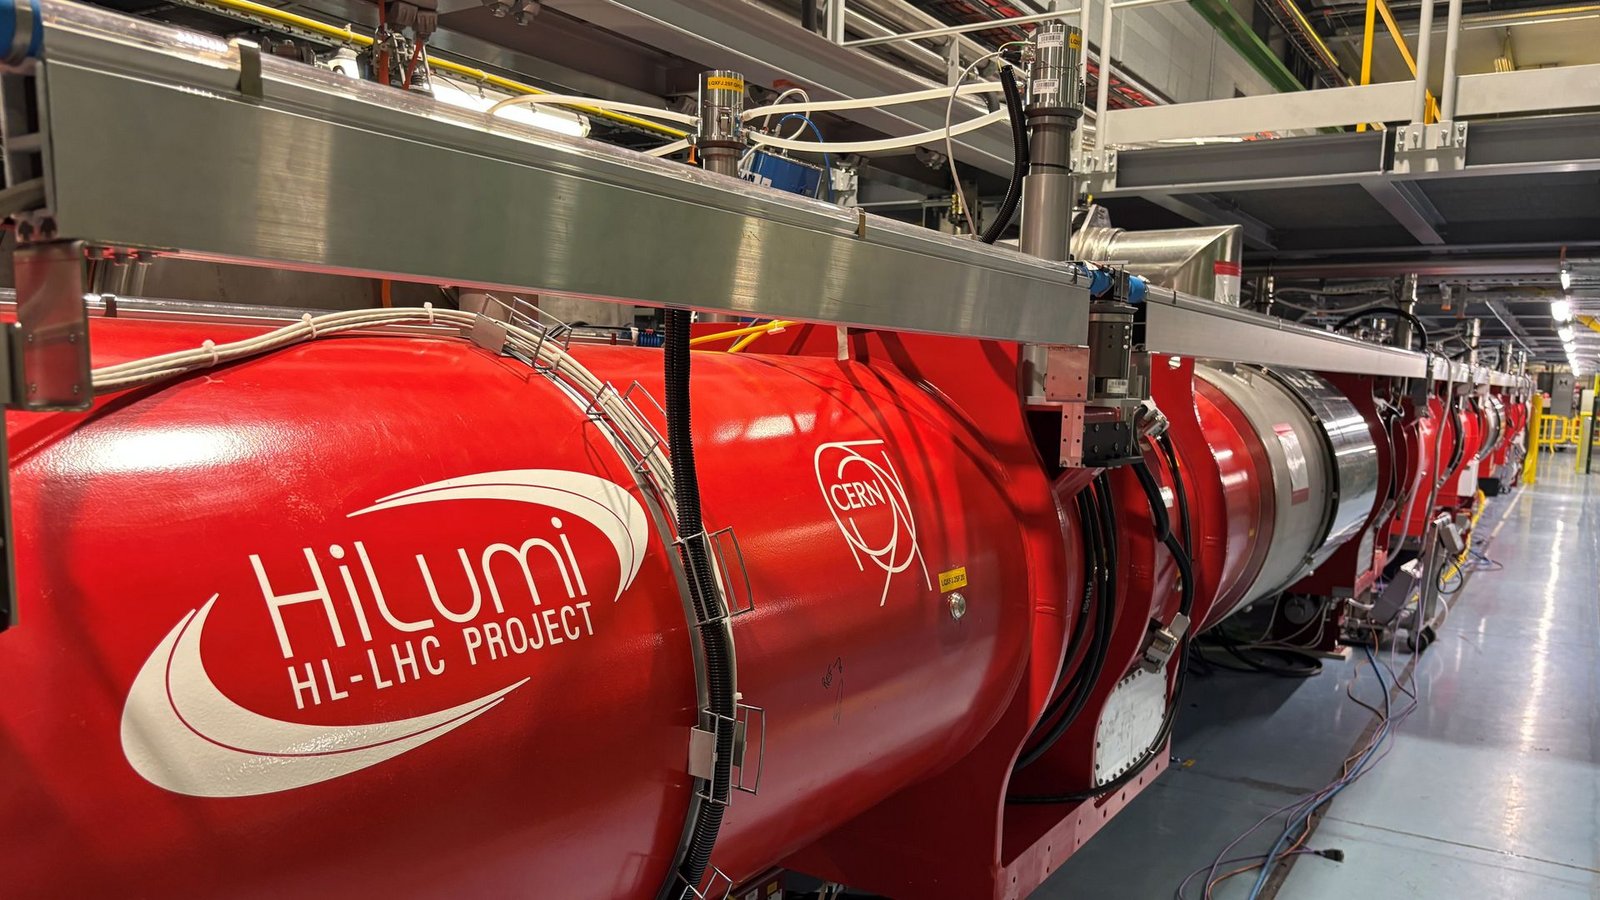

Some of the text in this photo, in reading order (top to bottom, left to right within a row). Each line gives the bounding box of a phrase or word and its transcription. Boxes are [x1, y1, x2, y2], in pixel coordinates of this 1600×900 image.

[830, 479, 886, 511] CERN
[249, 516, 588, 659] HiLumi
[287, 601, 594, 710] HL-LHC PROJECT
